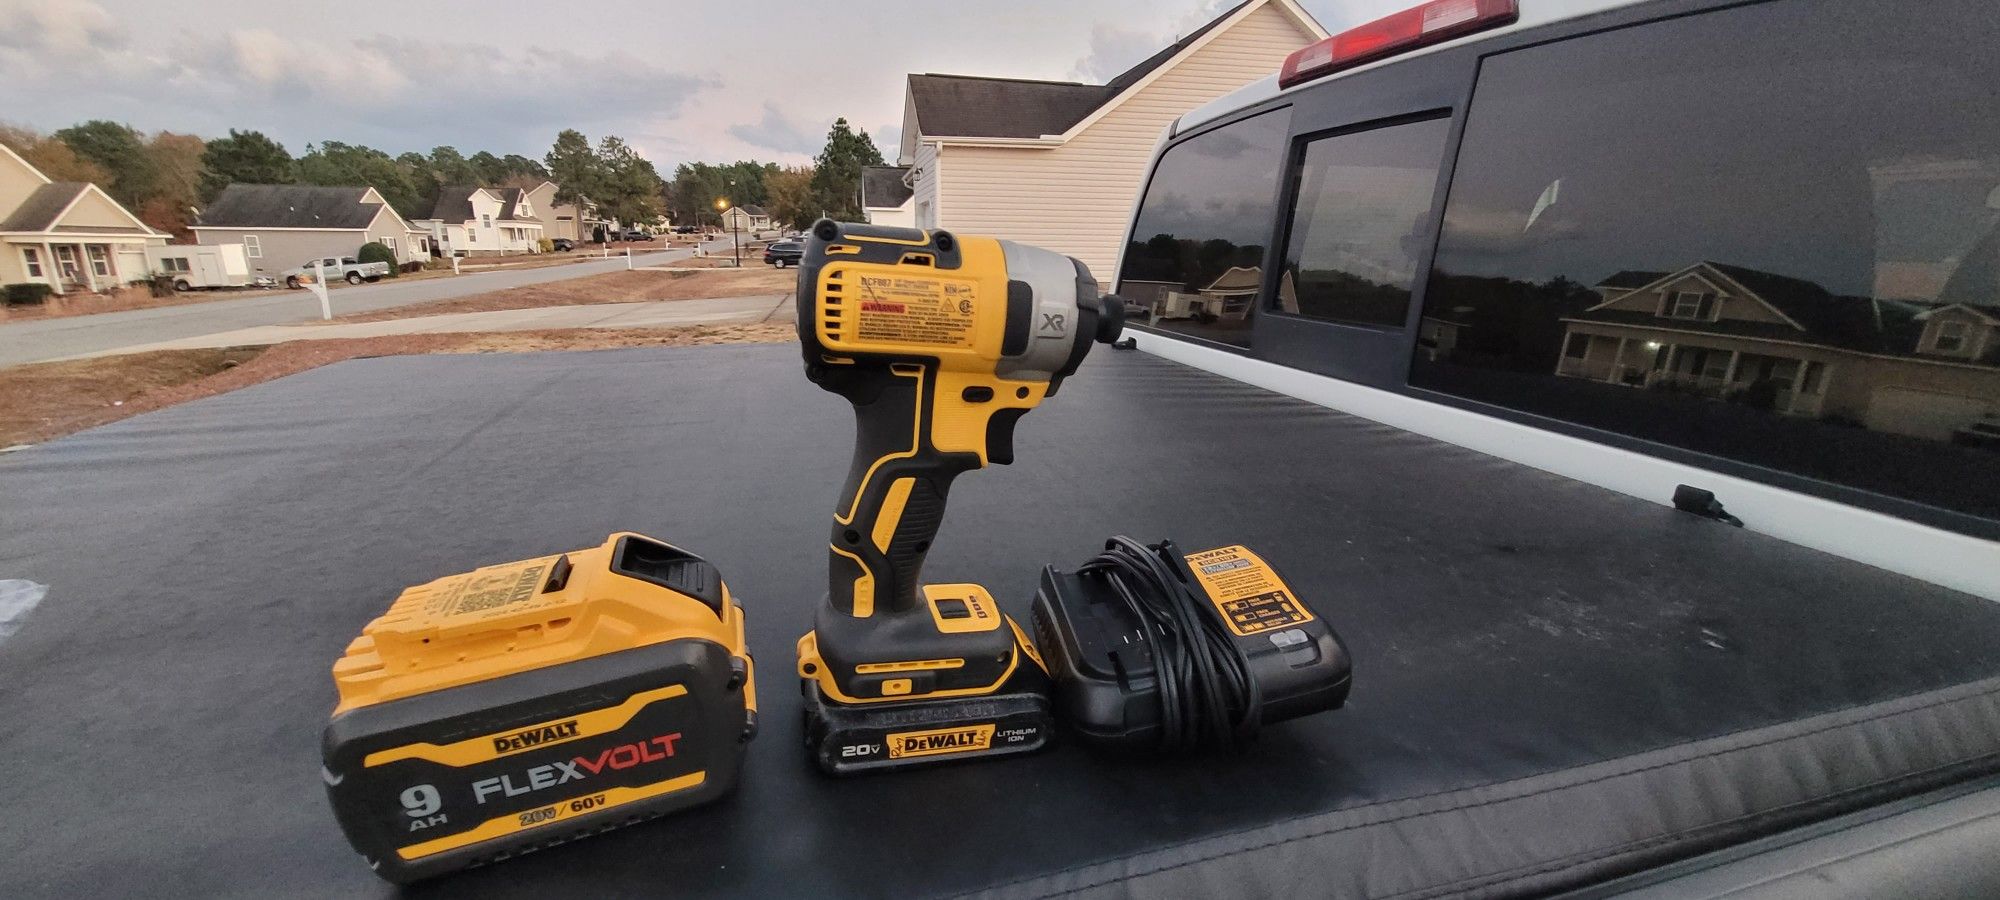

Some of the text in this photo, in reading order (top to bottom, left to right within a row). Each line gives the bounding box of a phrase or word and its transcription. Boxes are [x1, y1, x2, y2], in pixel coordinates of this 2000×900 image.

[1040, 313, 1064, 331] XR
[494, 721, 580, 753] DEWALT
[904, 732, 977, 751] DEWALT
[997, 727, 1037, 737] LITHIUM
[472, 733, 682, 804] FLEXVOLT
[400, 784, 441, 818] 9
[410, 814, 448, 832] AH
